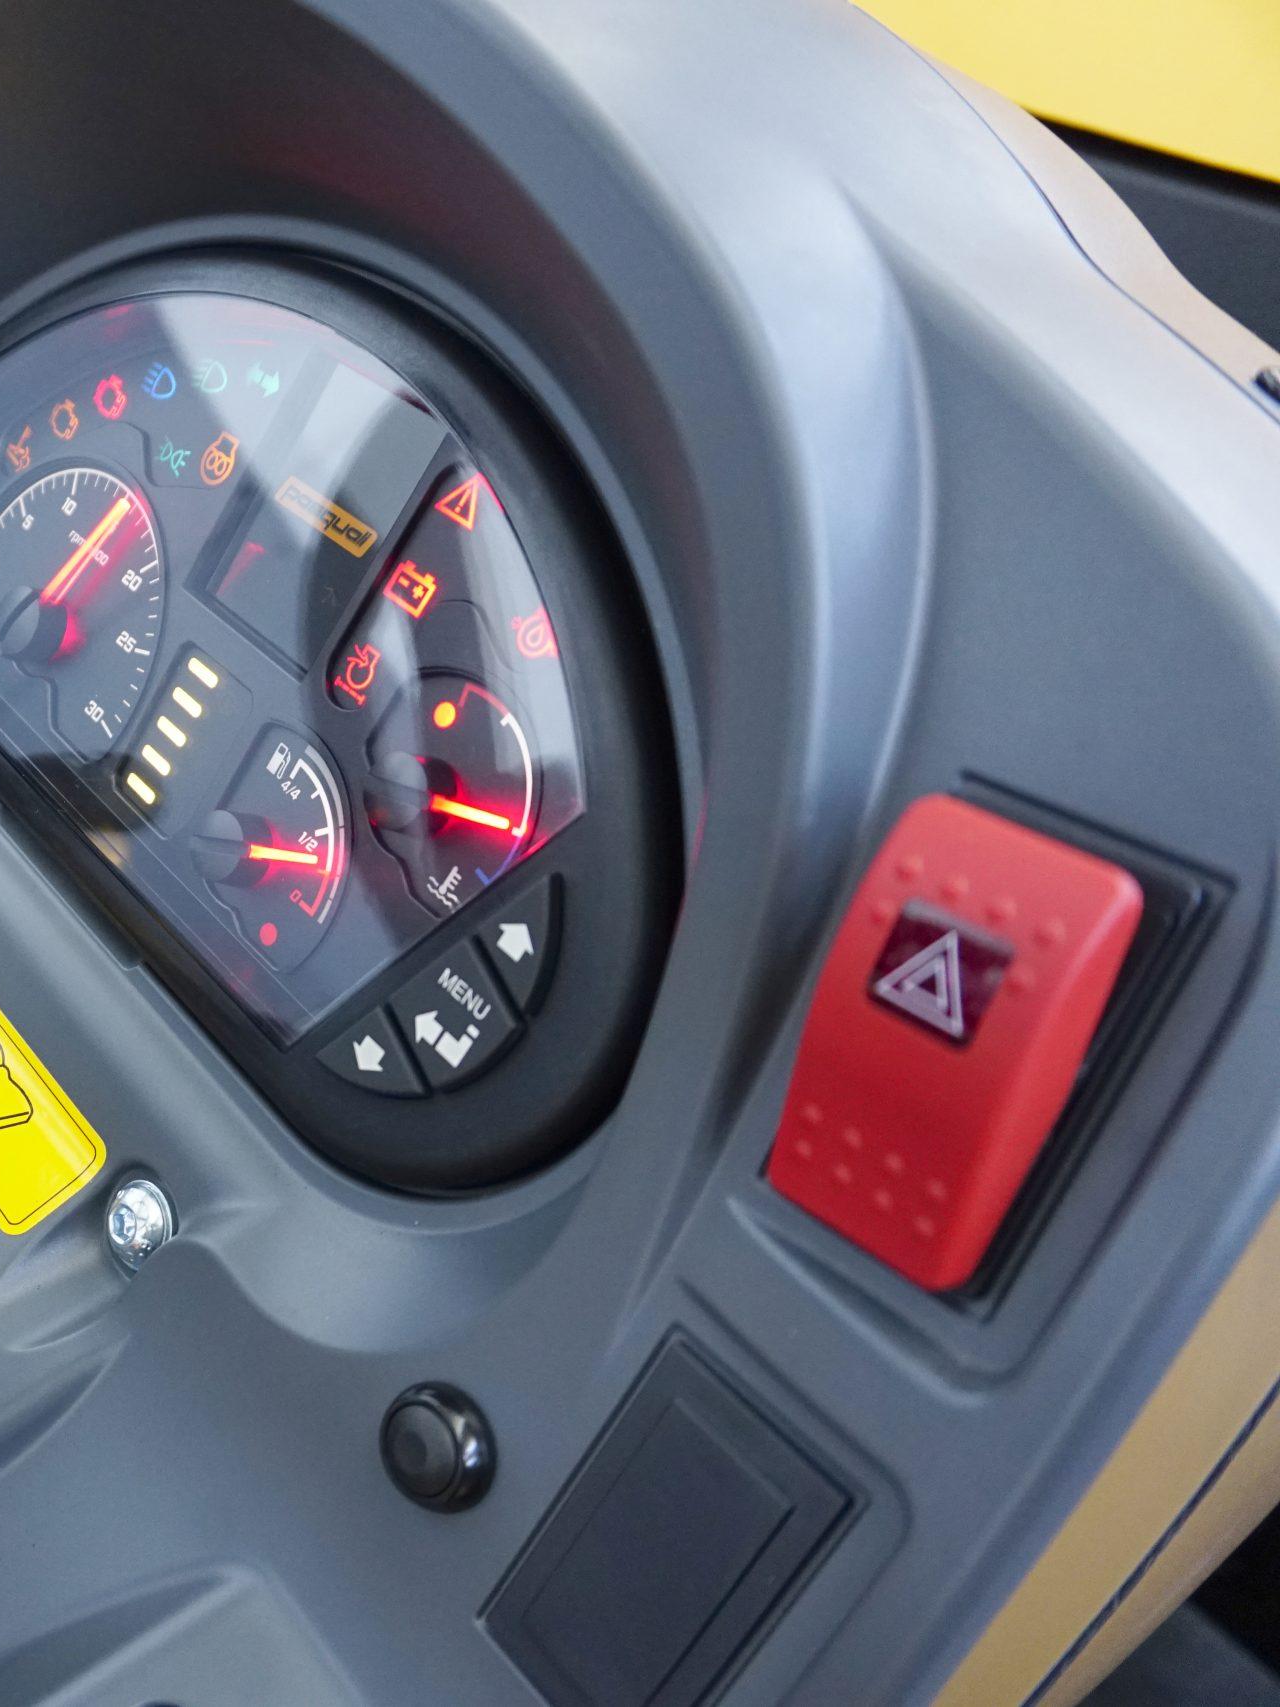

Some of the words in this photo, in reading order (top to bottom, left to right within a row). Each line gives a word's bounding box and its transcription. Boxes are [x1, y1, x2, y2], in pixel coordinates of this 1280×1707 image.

[61, 497, 77, 516] 10
[281, 485, 373, 547] paquali
[22, 514, 34, 530] 5
[121, 569, 142, 592] 20
[116, 630, 136, 652] 25
[84, 699, 105, 722] 30
[280, 780, 301, 801] 4/4
[298, 831, 319, 853] 1/2
[289, 888, 303, 904] 0
[437, 967, 492, 1020] MENU
